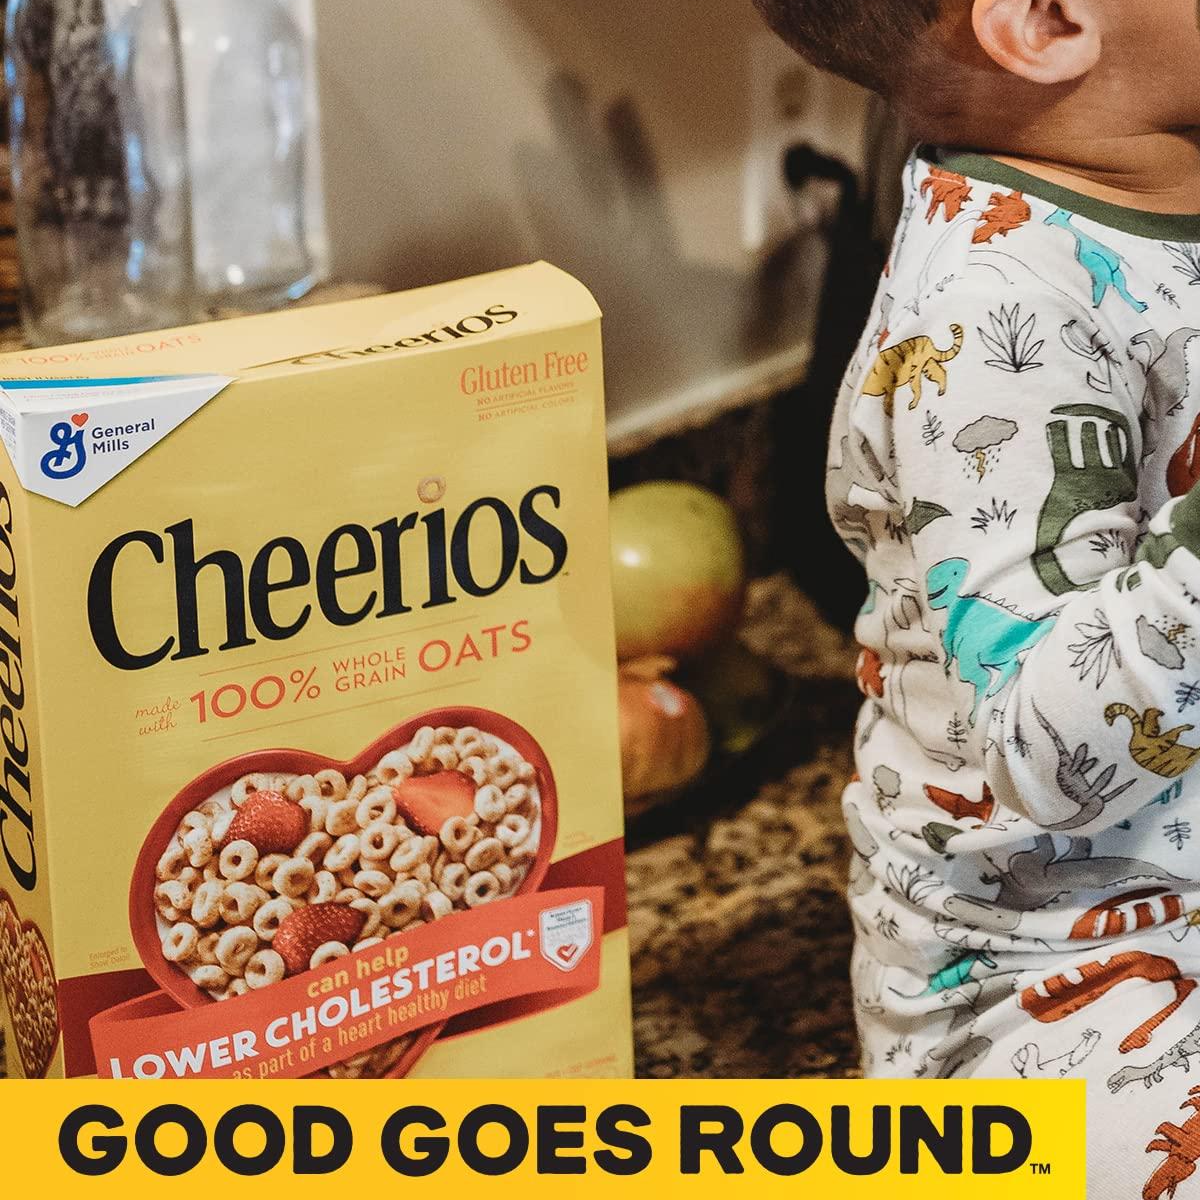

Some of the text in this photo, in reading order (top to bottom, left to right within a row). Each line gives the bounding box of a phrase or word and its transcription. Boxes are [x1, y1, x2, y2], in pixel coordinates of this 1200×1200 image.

[460, 351, 588, 395] Gluten Free
[477, 395, 491, 406] NO
[493, 388, 536, 403] ARTIFICIAL
[478, 412, 493, 422] NO
[495, 404, 538, 417] ARTIFICIAL
[92, 418, 155, 439] General
[92, 440, 130, 455] Mills
[87, 476, 568, 671] Cheerios
[332, 647, 406, 673] WHOLE
[418, 620, 532, 673] OATS
[335, 664, 406, 692] GRAIN
[134, 697, 182, 719] made
[190, 666, 321, 723] 100%
[138, 715, 177, 737] with
[307, 945, 409, 998] can help
[258, 1048, 296, 1079] part
[300, 1040, 317, 1062] of
[322, 1036, 333, 1053] a
[339, 1015, 382, 1046] heart
[389, 988, 450, 1022] healthy
[454, 974, 488, 1000] diet
[110, 1030, 260, 1079] LOWER
